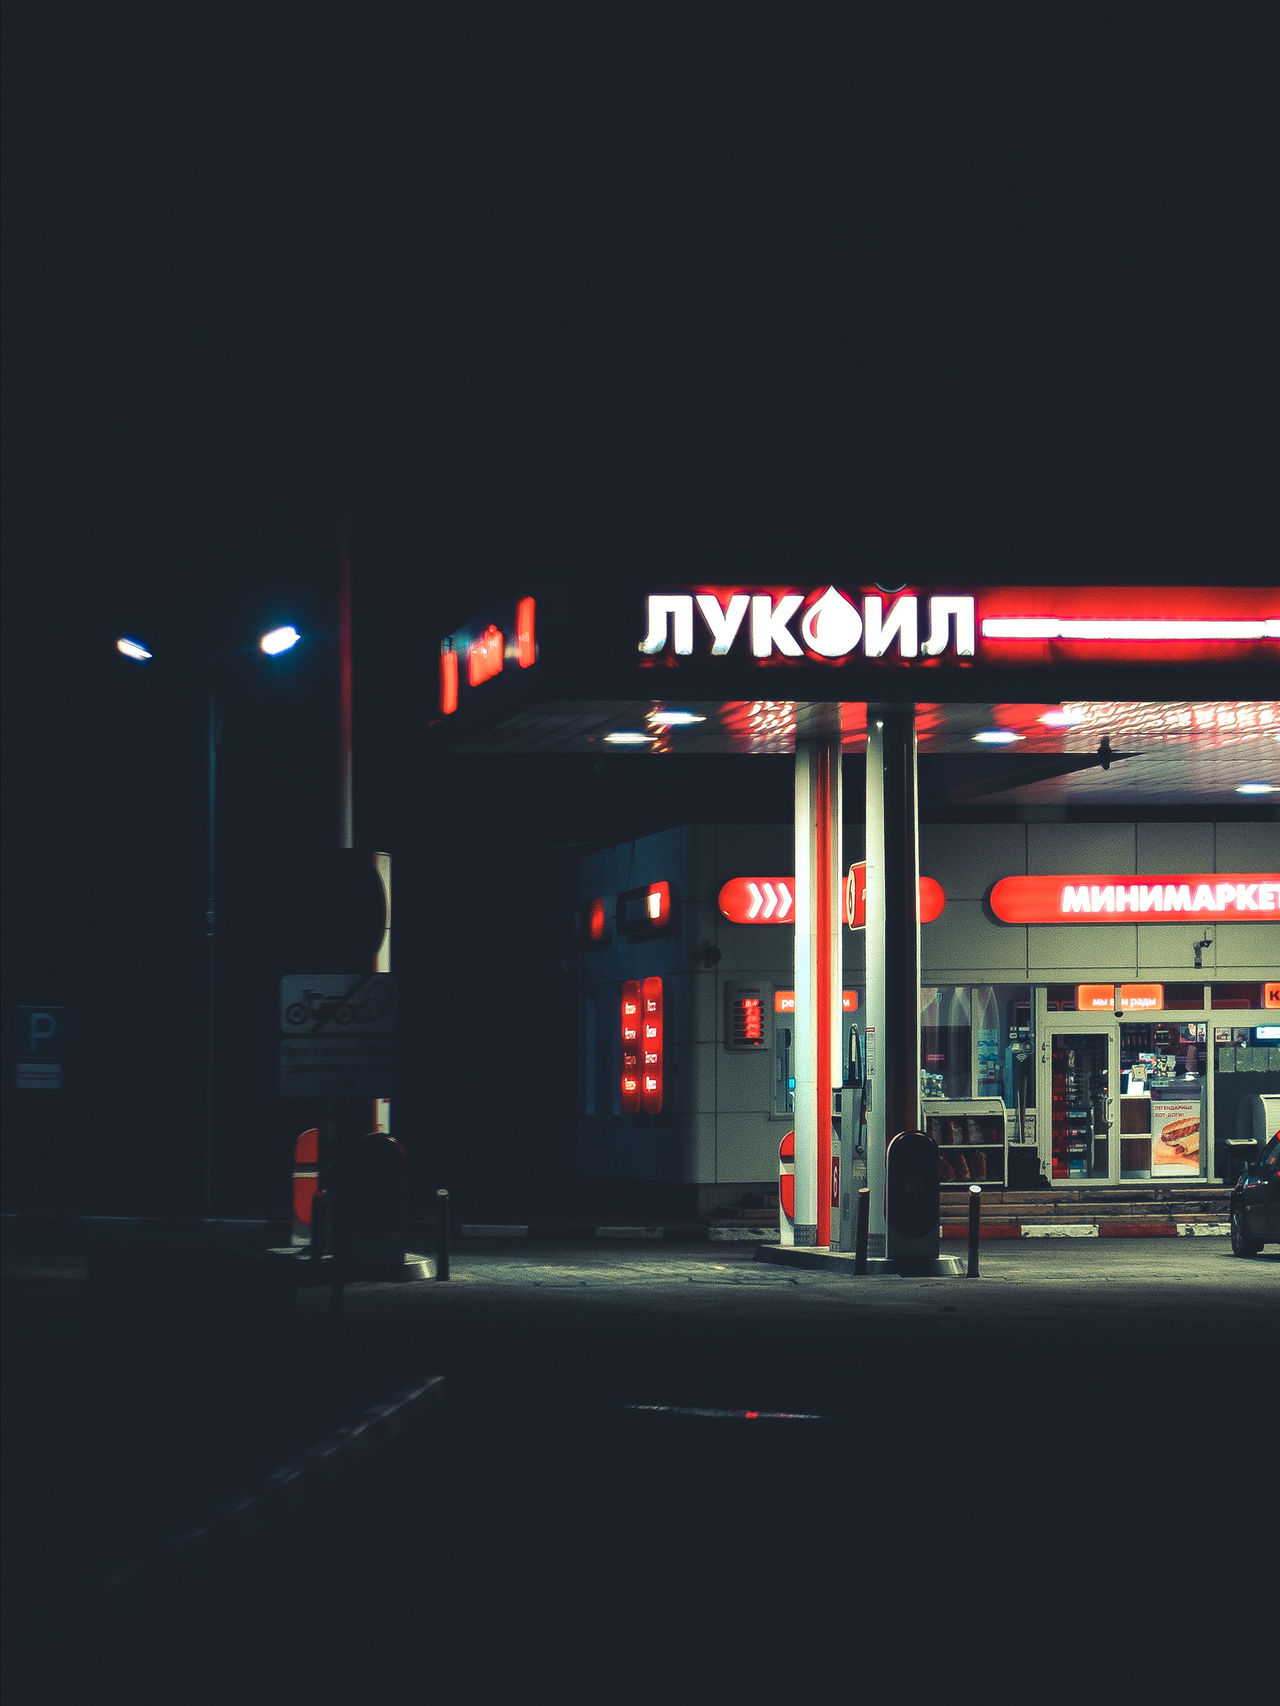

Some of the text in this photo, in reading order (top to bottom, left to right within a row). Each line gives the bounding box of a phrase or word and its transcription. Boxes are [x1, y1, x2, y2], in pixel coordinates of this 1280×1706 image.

[638, 582, 975, 657] ЛУКОЙЛ
[1110, 998, 1128, 1006] вм
[1130, 998, 1156, 1008] рады
[28, 1012, 57, 1052] P
